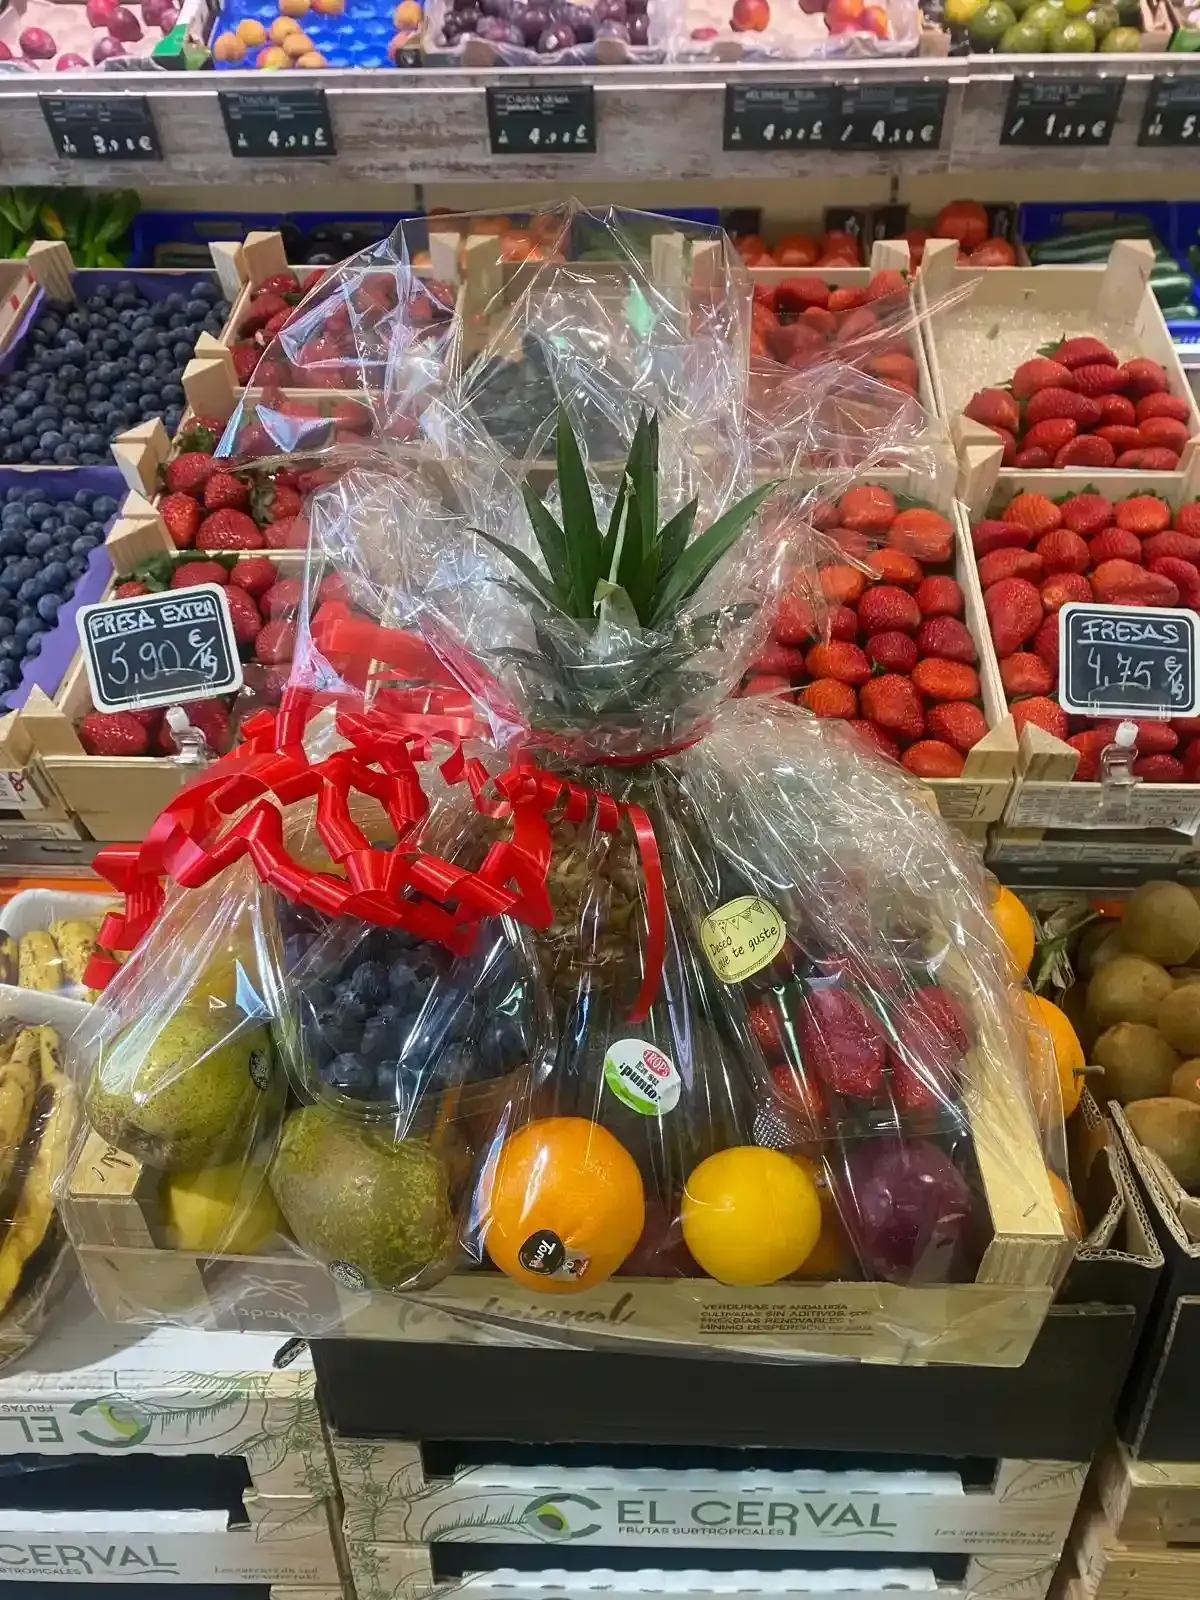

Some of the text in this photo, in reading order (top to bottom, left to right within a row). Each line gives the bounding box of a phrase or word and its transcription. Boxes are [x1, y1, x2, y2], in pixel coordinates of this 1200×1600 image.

[91, 600, 216, 637] FRESA EXTRA
[1082, 620, 1179, 643] FRESAS
[108, 640, 180, 684] 5,90
[1088, 647, 1154, 691] 4,75
[732, 945, 745, 958] te
[749, 926, 778, 952] guste
[635, 1061, 659, 1087] En su
[1, 1404, 54, 1412] FRUTAS
[0, 1415, 64, 1442] EL
[617, 1500, 897, 1536] EL CERVAL
[618, 1526, 785, 1536] FRUTAS SUBTROPICALES
[0, 1544, 177, 1574] CERVAL
